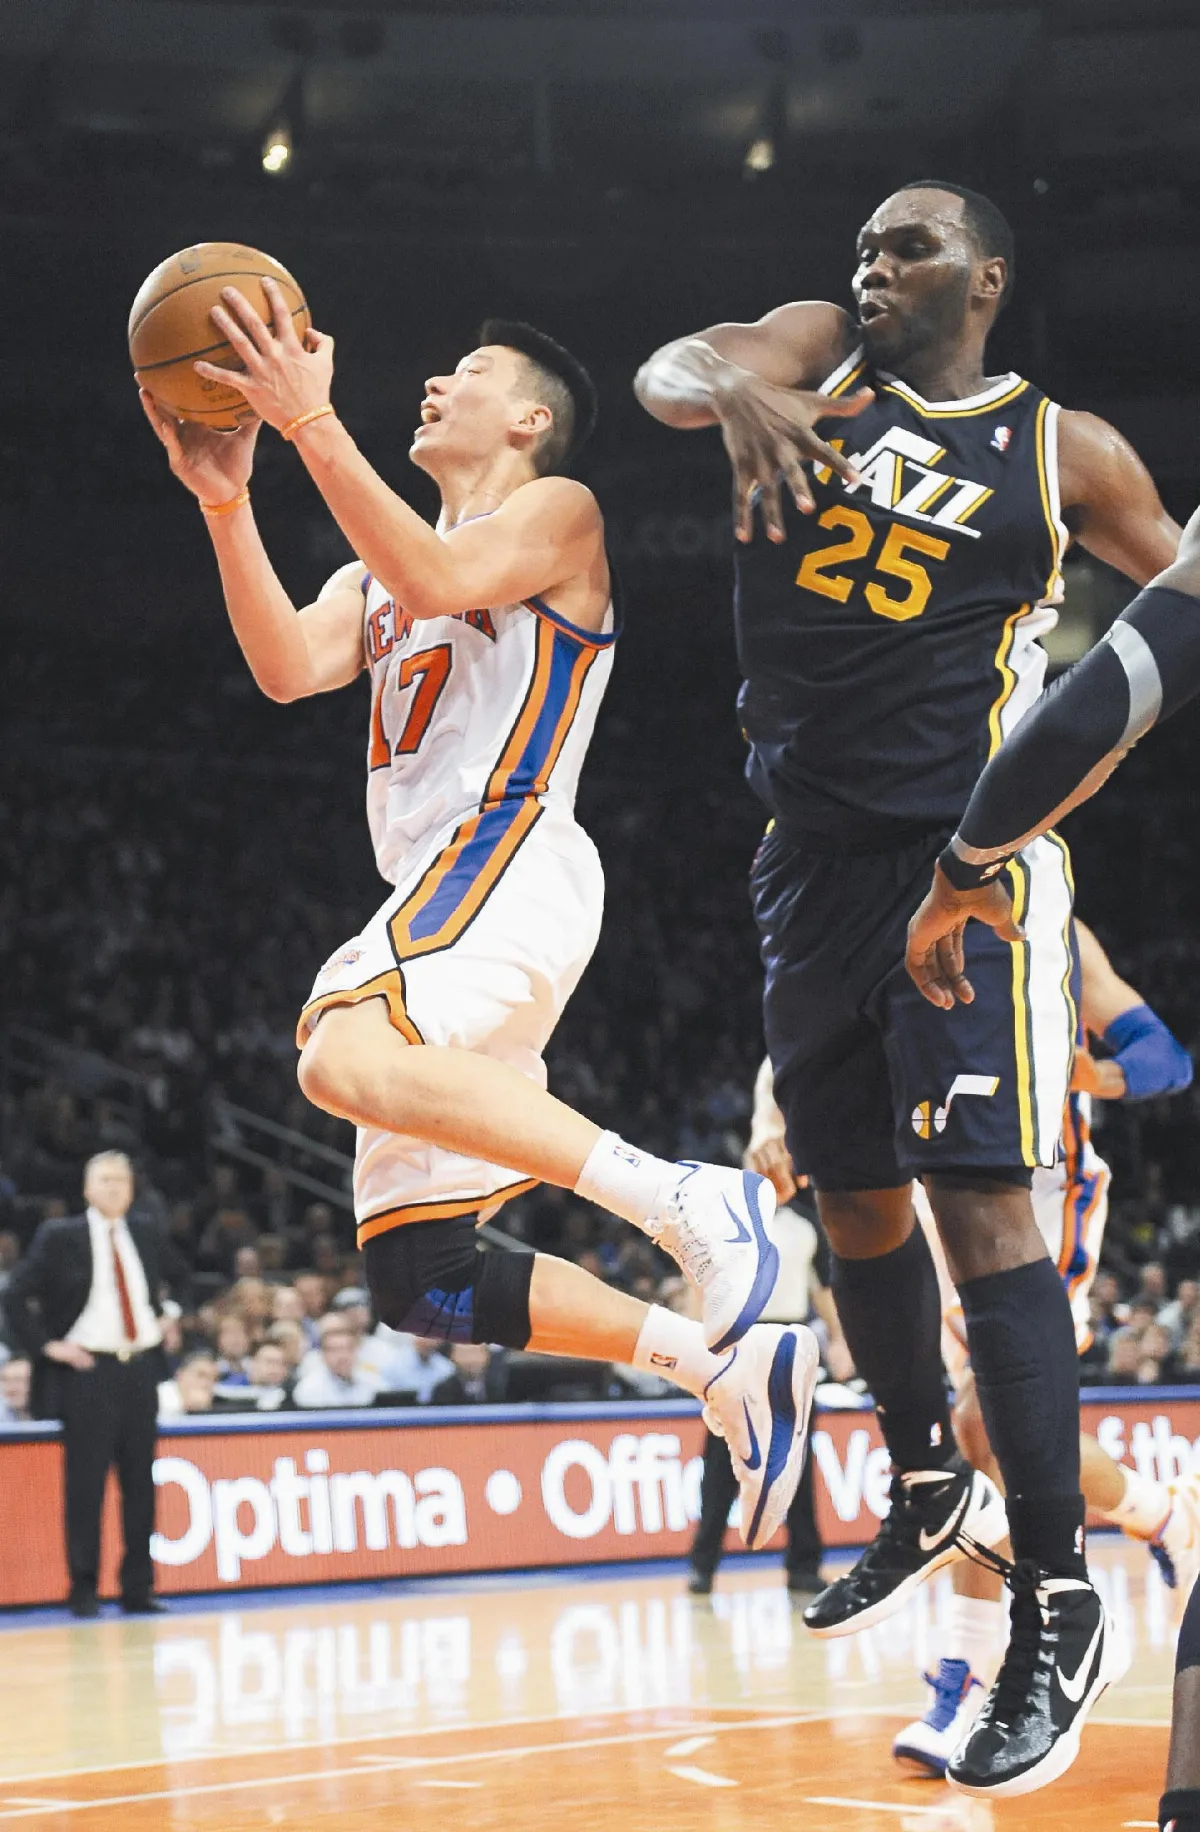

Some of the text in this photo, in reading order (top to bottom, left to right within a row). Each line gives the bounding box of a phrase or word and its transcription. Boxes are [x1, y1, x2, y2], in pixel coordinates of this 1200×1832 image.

[795, 504, 950, 622] 25
[370, 642, 453, 772] 17
[149, 1448, 469, 1582] Optima
